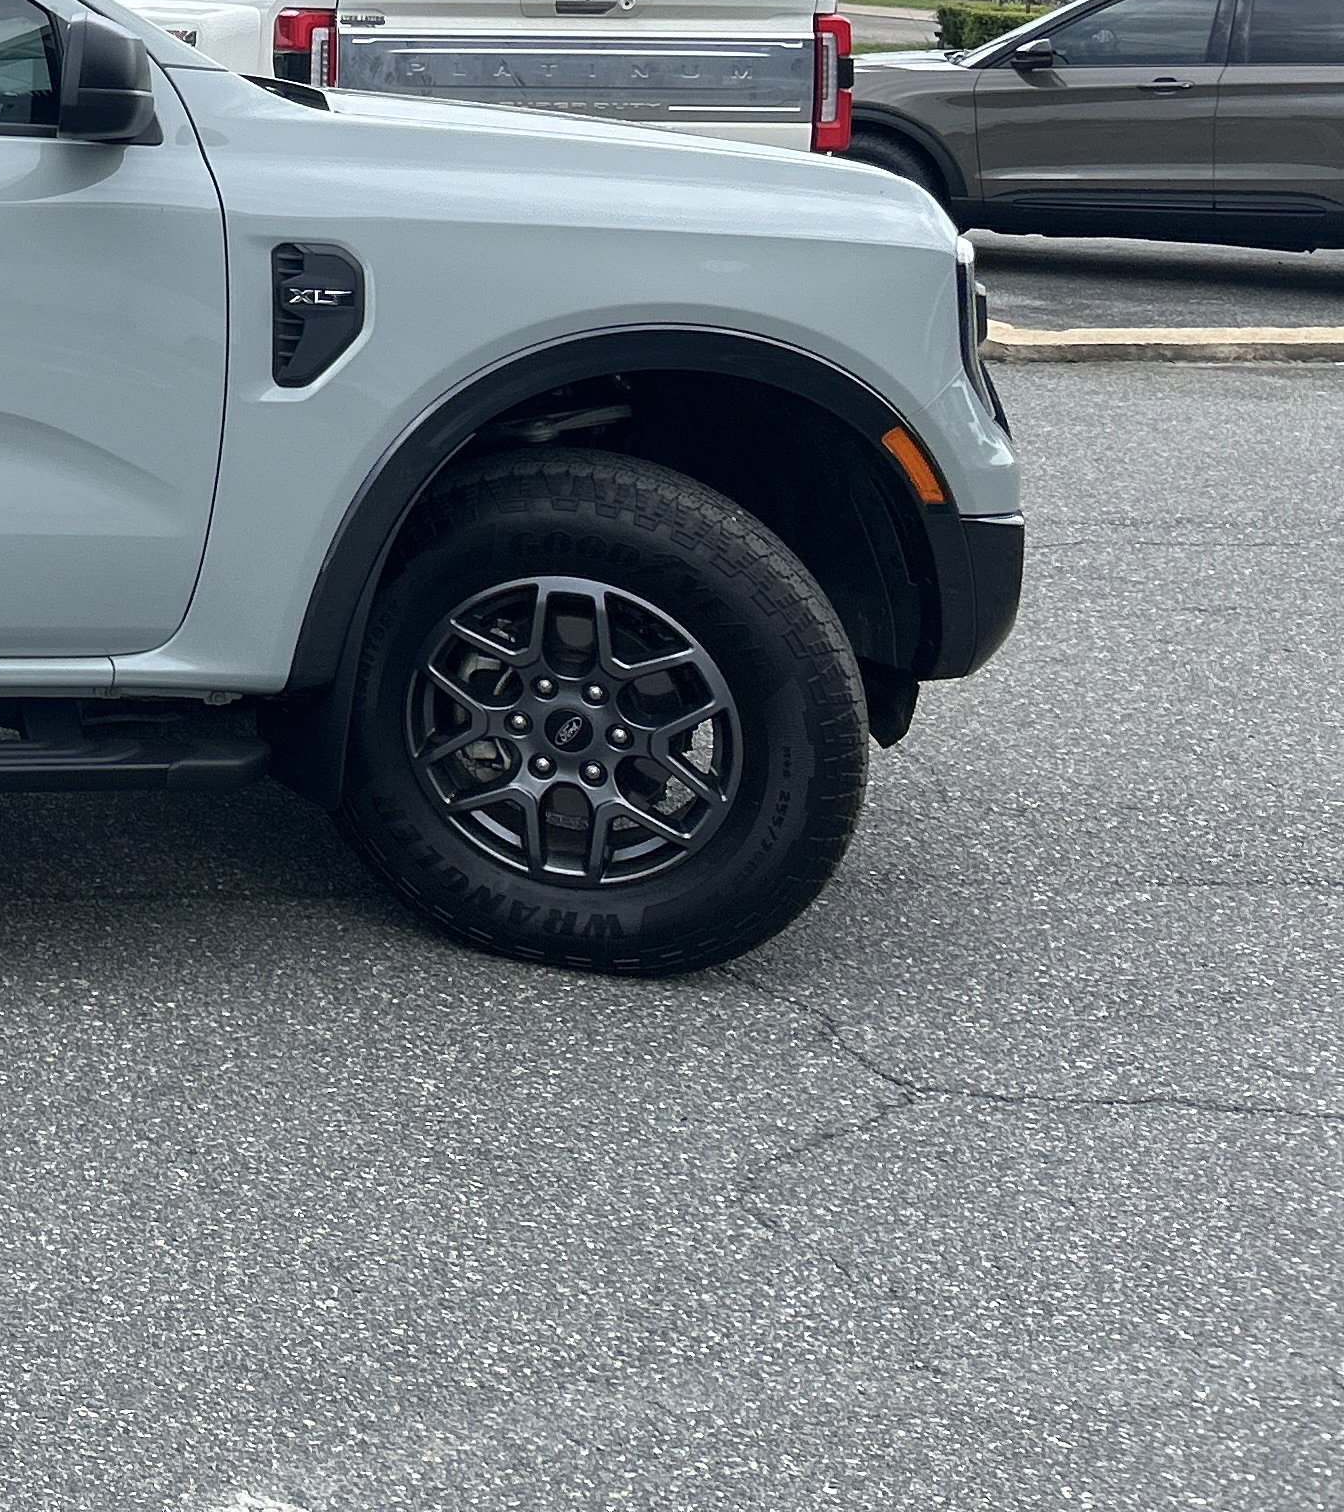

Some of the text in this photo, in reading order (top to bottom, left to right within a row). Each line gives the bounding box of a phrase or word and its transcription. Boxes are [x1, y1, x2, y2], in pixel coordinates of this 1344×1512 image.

[405, 60, 754, 80] PLATINUM
[593, 102, 661, 110] DUTY
[288, 287, 354, 307] XLT
